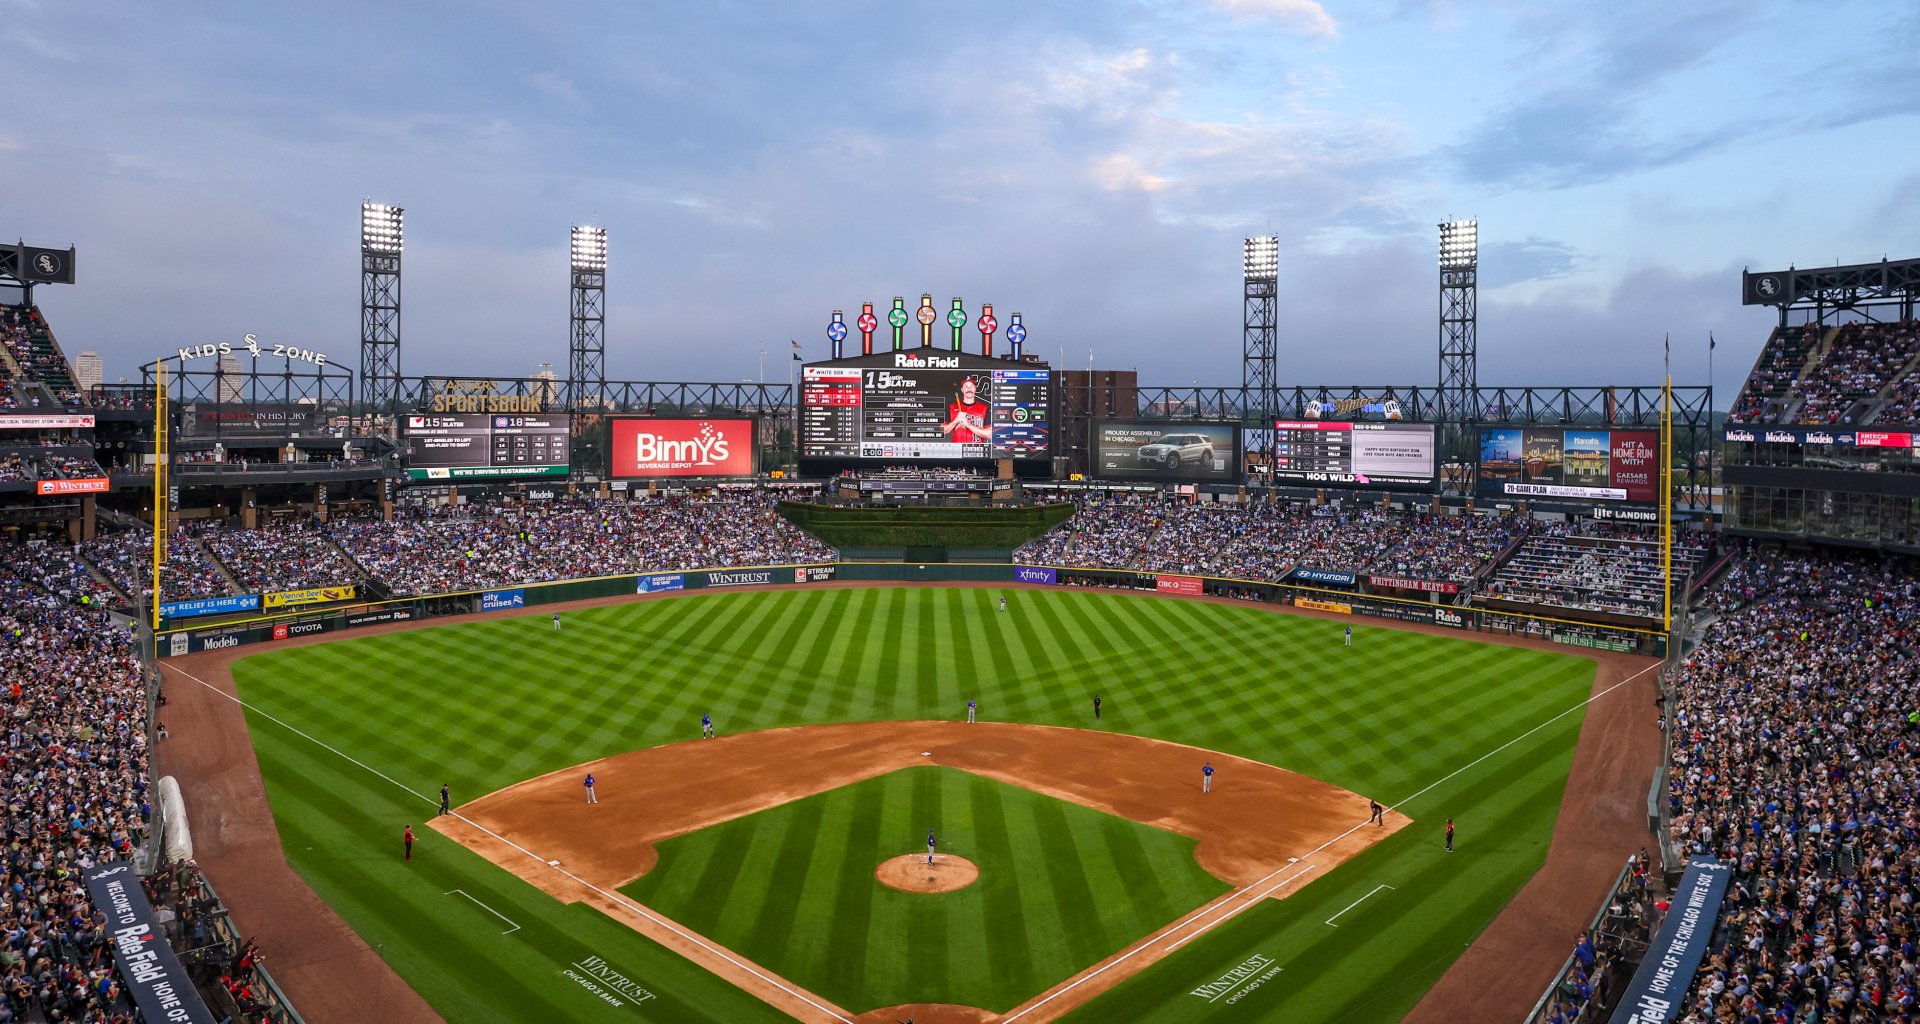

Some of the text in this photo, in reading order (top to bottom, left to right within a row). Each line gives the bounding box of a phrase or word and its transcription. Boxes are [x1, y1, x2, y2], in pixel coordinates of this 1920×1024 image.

[178, 342, 232, 361] KIDS
[273, 343, 327, 366] ZONE
[895, 354, 959, 368] Rate Field
[434, 380, 499, 391] CAESARS
[865, 372, 891, 389] 15
[434, 395, 541, 413] SPORTSBOOK
[1334, 398, 1374, 417] Miller
[256, 412, 266, 420] IN
[426, 417, 440, 427] 15
[510, 417, 523, 427] 18
[1726, 431, 1755, 442] Modelo
[1766, 432, 1796, 443] Modelo
[1806, 432, 1834, 444] Modelo
[1612, 448, 1653, 459] HOME RUN
[1622, 458, 1644, 466] WITH
[1306, 473, 1328, 481] HOG
[1330, 474, 1355, 482] WILD
[59, 482, 106, 490] WINTRUST
[1507, 485, 1547, 494] 20-GAME PLAN
[530, 490, 554, 500] Modelo
[1594, 508, 1657, 521] Lite LANDING
[708, 572, 771, 584] WINTRUST
[1020, 570, 1050, 583] xfinity
[1312, 572, 1350, 582] HYUNDAI
[1158, 580, 1173, 588] CIBC
[1370, 577, 1445, 593] WHITTINGHAM MEATS
[280, 592, 304, 600] Vienna
[483, 594, 498, 602] city
[179, 602, 206, 610] RELIEF
[216, 599, 237, 607] HERE
[483, 599, 512, 609] cruises
[394, 612, 410, 620] Rate
[1436, 609, 1461, 623] Rate
[290, 624, 322, 633] TOYOTA
[204, 636, 238, 651] Modelo
[1570, 639, 1593, 648] RUSH
[1697, 873, 1714, 890] SOX
[1688, 885, 1709, 911] WHITE
[1678, 908, 1701, 941] CHICAGO
[106, 880, 189, 1024] WELCOME TO Rate Field HOME OF
[1668, 938, 1689, 957] THE
[1662, 955, 1680, 969] OF
[580, 955, 657, 1002] WINTRUST
[1190, 954, 1270, 999] WINTRUST
[1648, 966, 1676, 994] HOME
[562, 970, 625, 1008] CHICAGO'S BANK
[1226, 966, 1285, 1005] CHICAGO'S BANK
